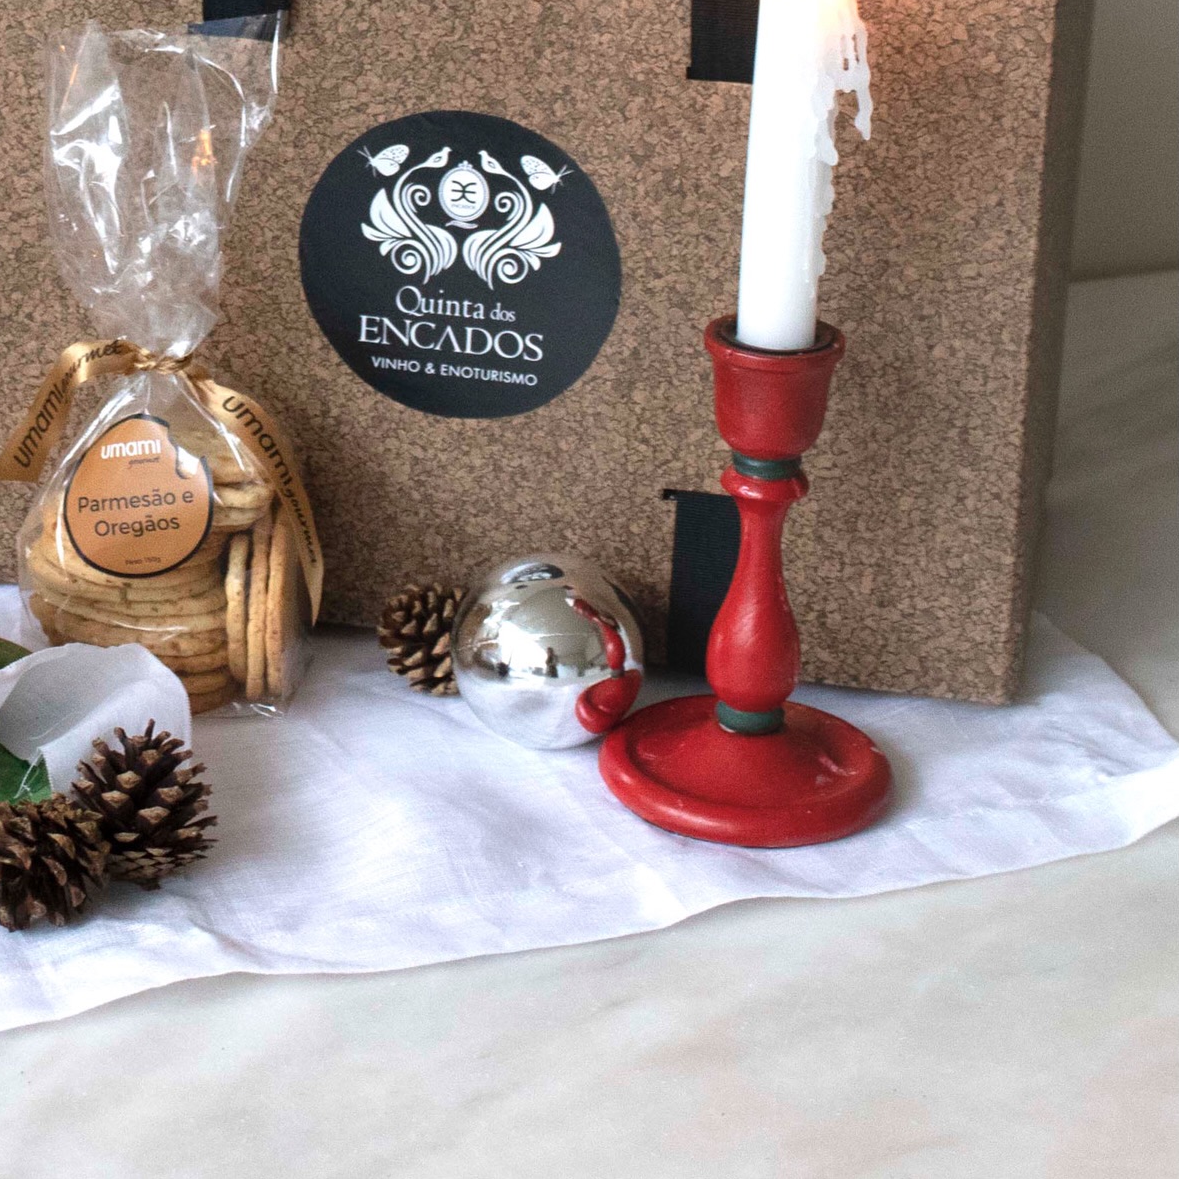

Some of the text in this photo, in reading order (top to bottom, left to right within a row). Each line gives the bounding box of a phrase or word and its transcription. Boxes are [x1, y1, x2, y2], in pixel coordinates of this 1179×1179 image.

[395, 285, 516, 322] Quinta dos
[357, 314, 544, 362] ENCADOS
[371, 355, 538, 386] VINHO & ENOTURISMO
[13, 384, 63, 468] umami
[222, 395, 292, 487] umami
[100, 438, 162, 460] umami
[78, 488, 194, 514] Parmesão e
[94, 514, 180, 538] Oregãos
